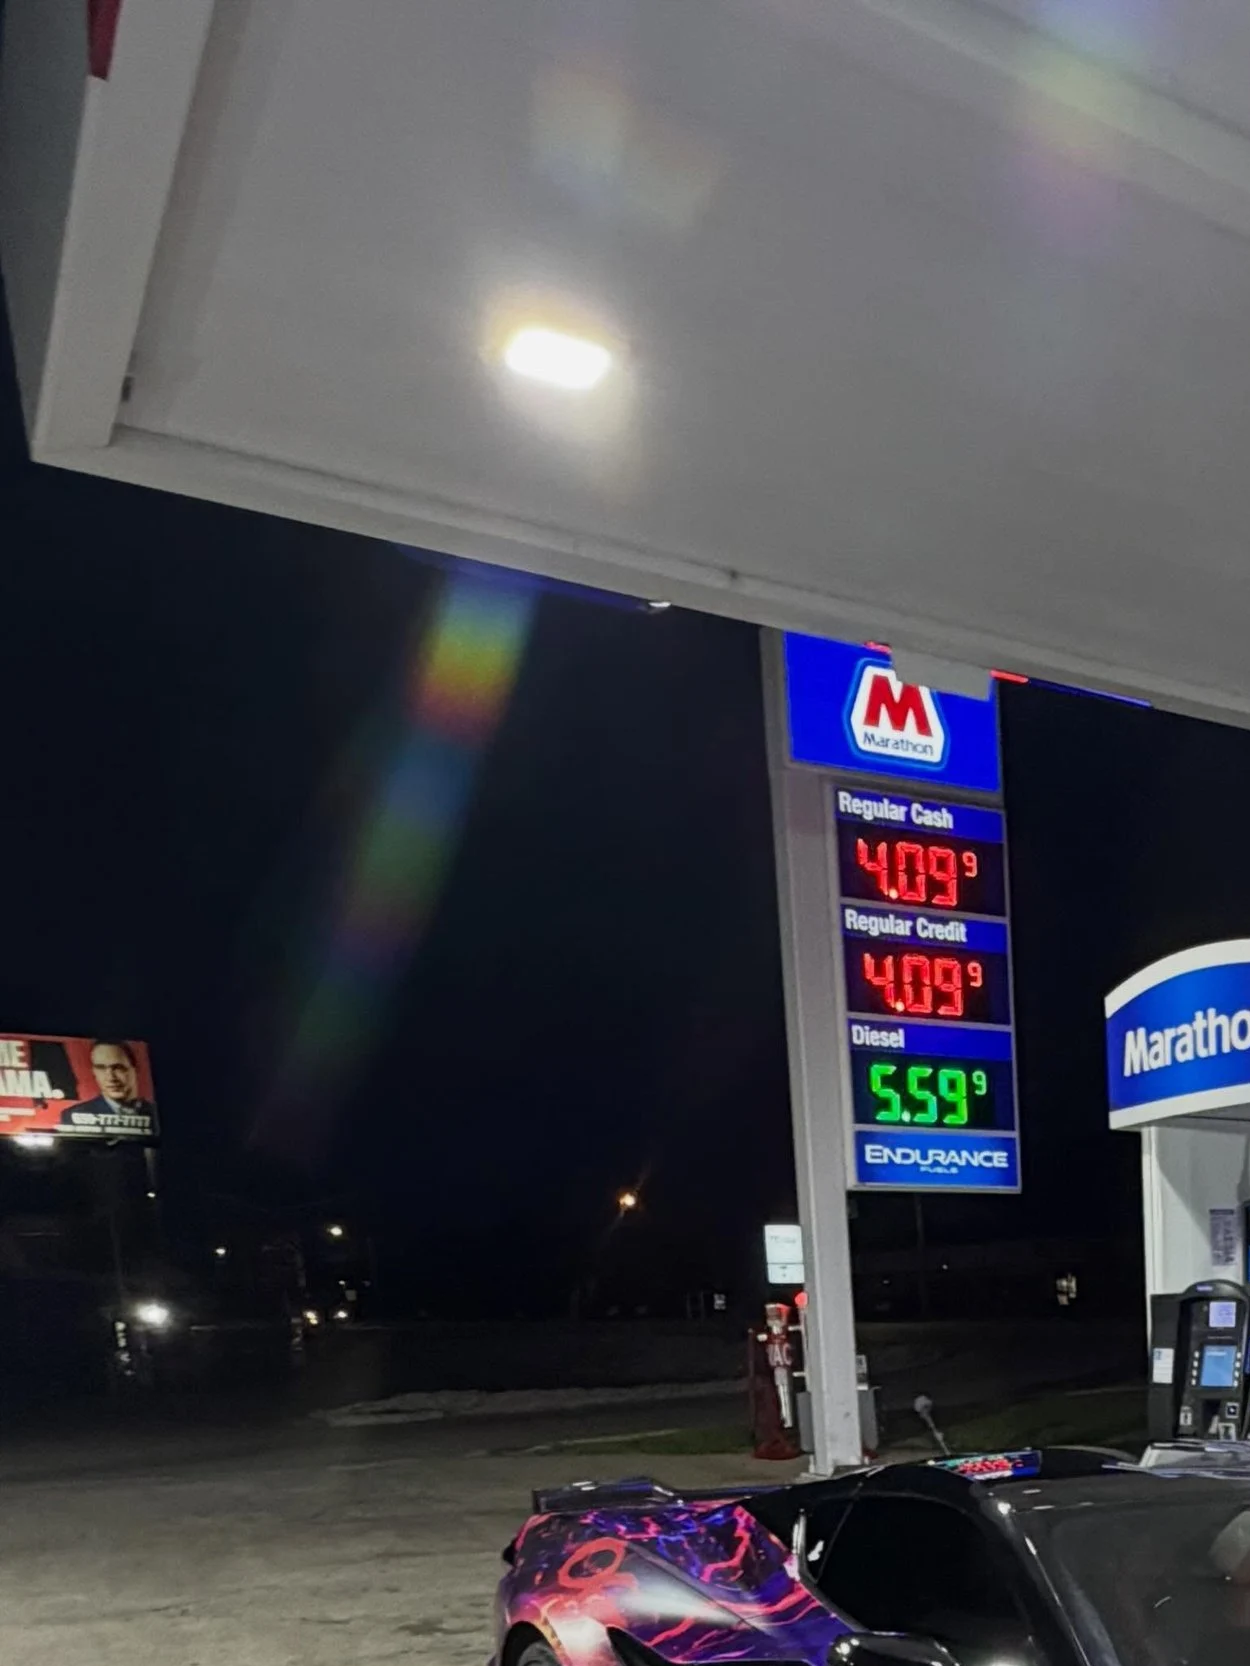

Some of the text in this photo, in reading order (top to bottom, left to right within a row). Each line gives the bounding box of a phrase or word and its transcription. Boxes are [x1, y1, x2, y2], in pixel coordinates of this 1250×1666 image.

[863, 674, 932, 737] M
[863, 732, 934, 756] Marathon
[838, 791, 954, 829] Regular Cash
[845, 909, 968, 942] Regular Credit
[851, 1025, 905, 1048] Diesel
[864, 1144, 1009, 1168] ENDURANCE
